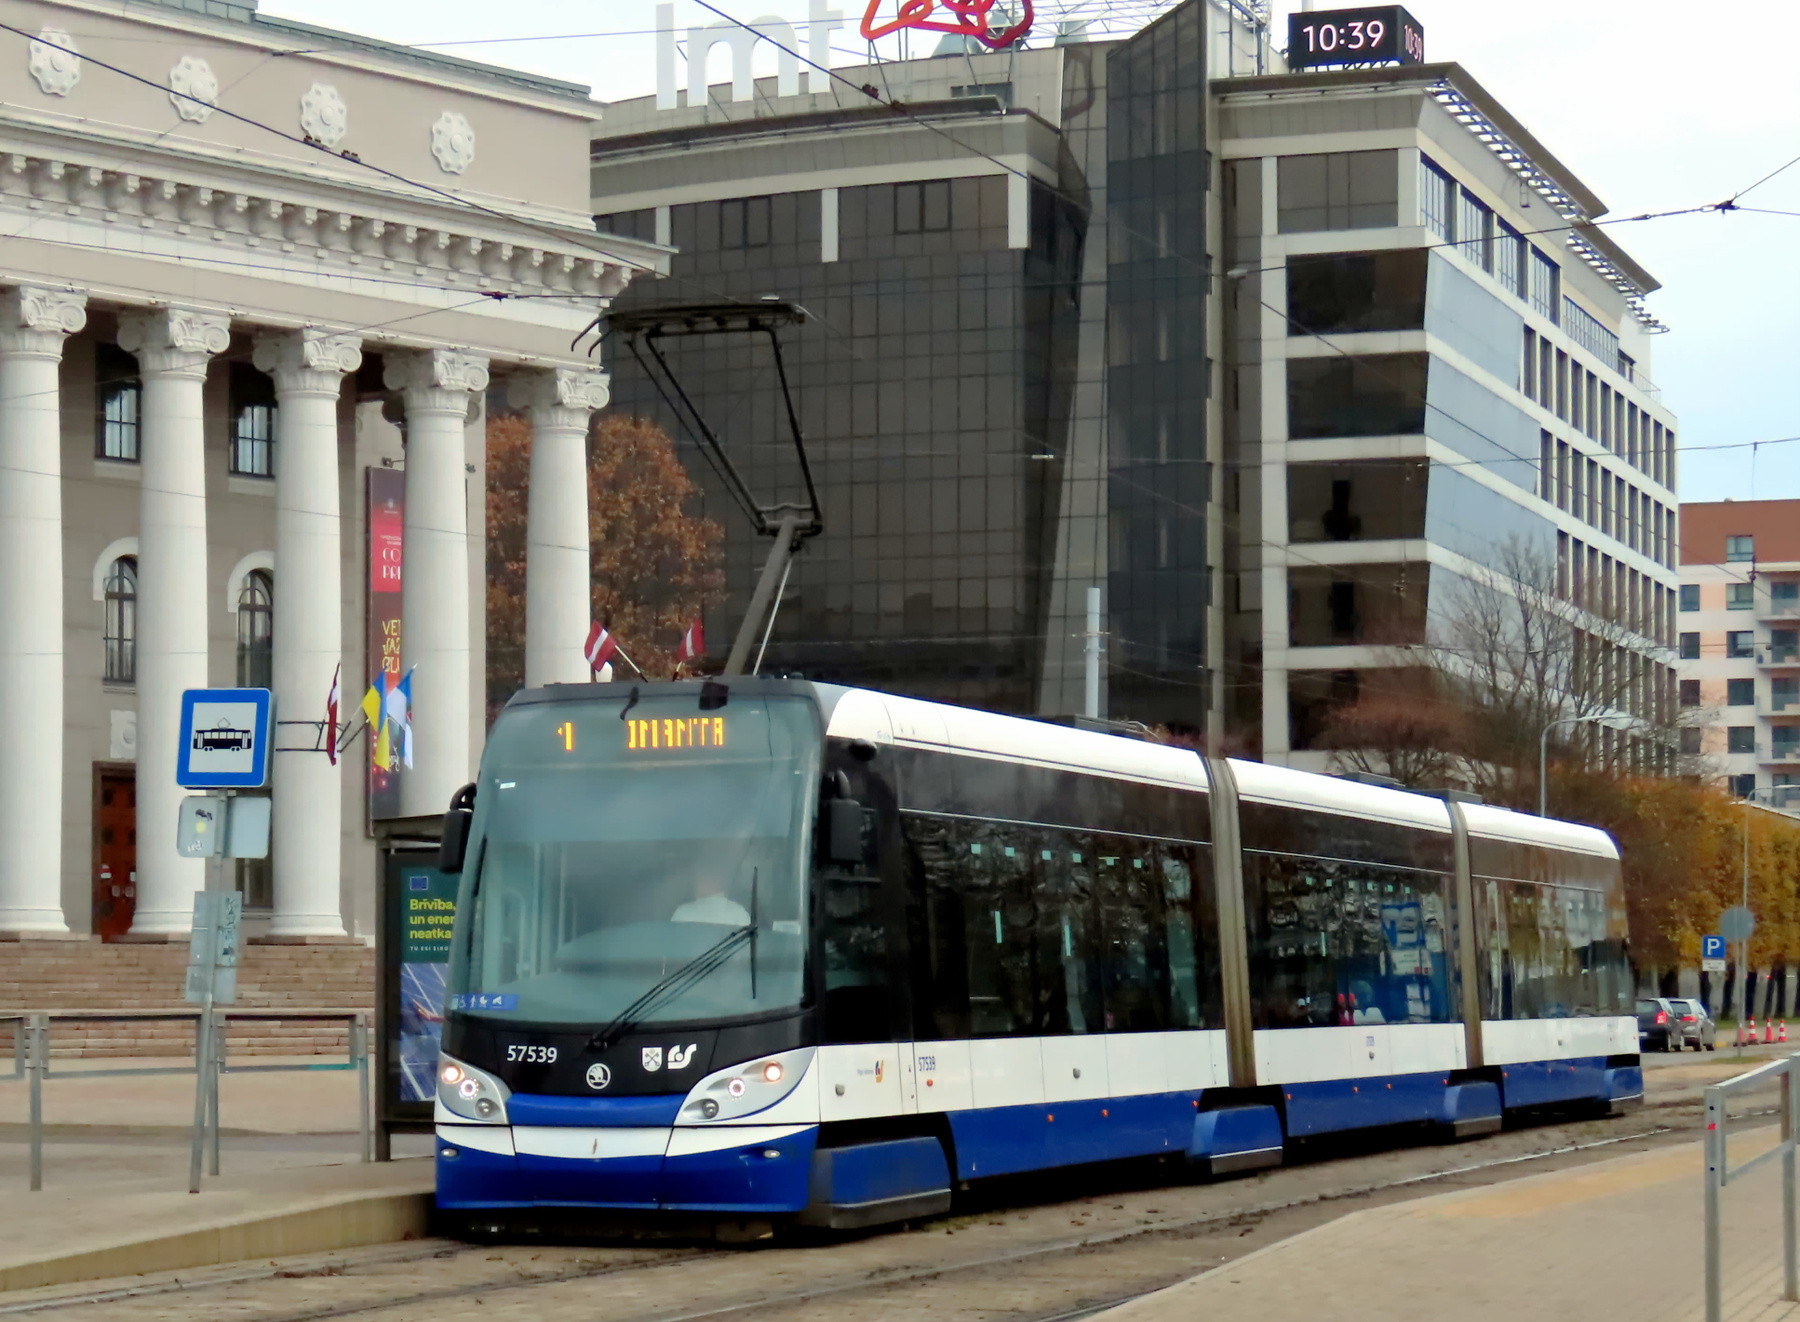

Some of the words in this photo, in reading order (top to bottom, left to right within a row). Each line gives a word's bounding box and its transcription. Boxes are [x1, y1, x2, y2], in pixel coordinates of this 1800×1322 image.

[1302, 20, 1385, 52] 10:39
[1404, 24, 1423, 62] 10:39
[409, 915, 426, 925] un
[1707, 938, 1720, 956] P
[506, 1045, 557, 1063] 57539
